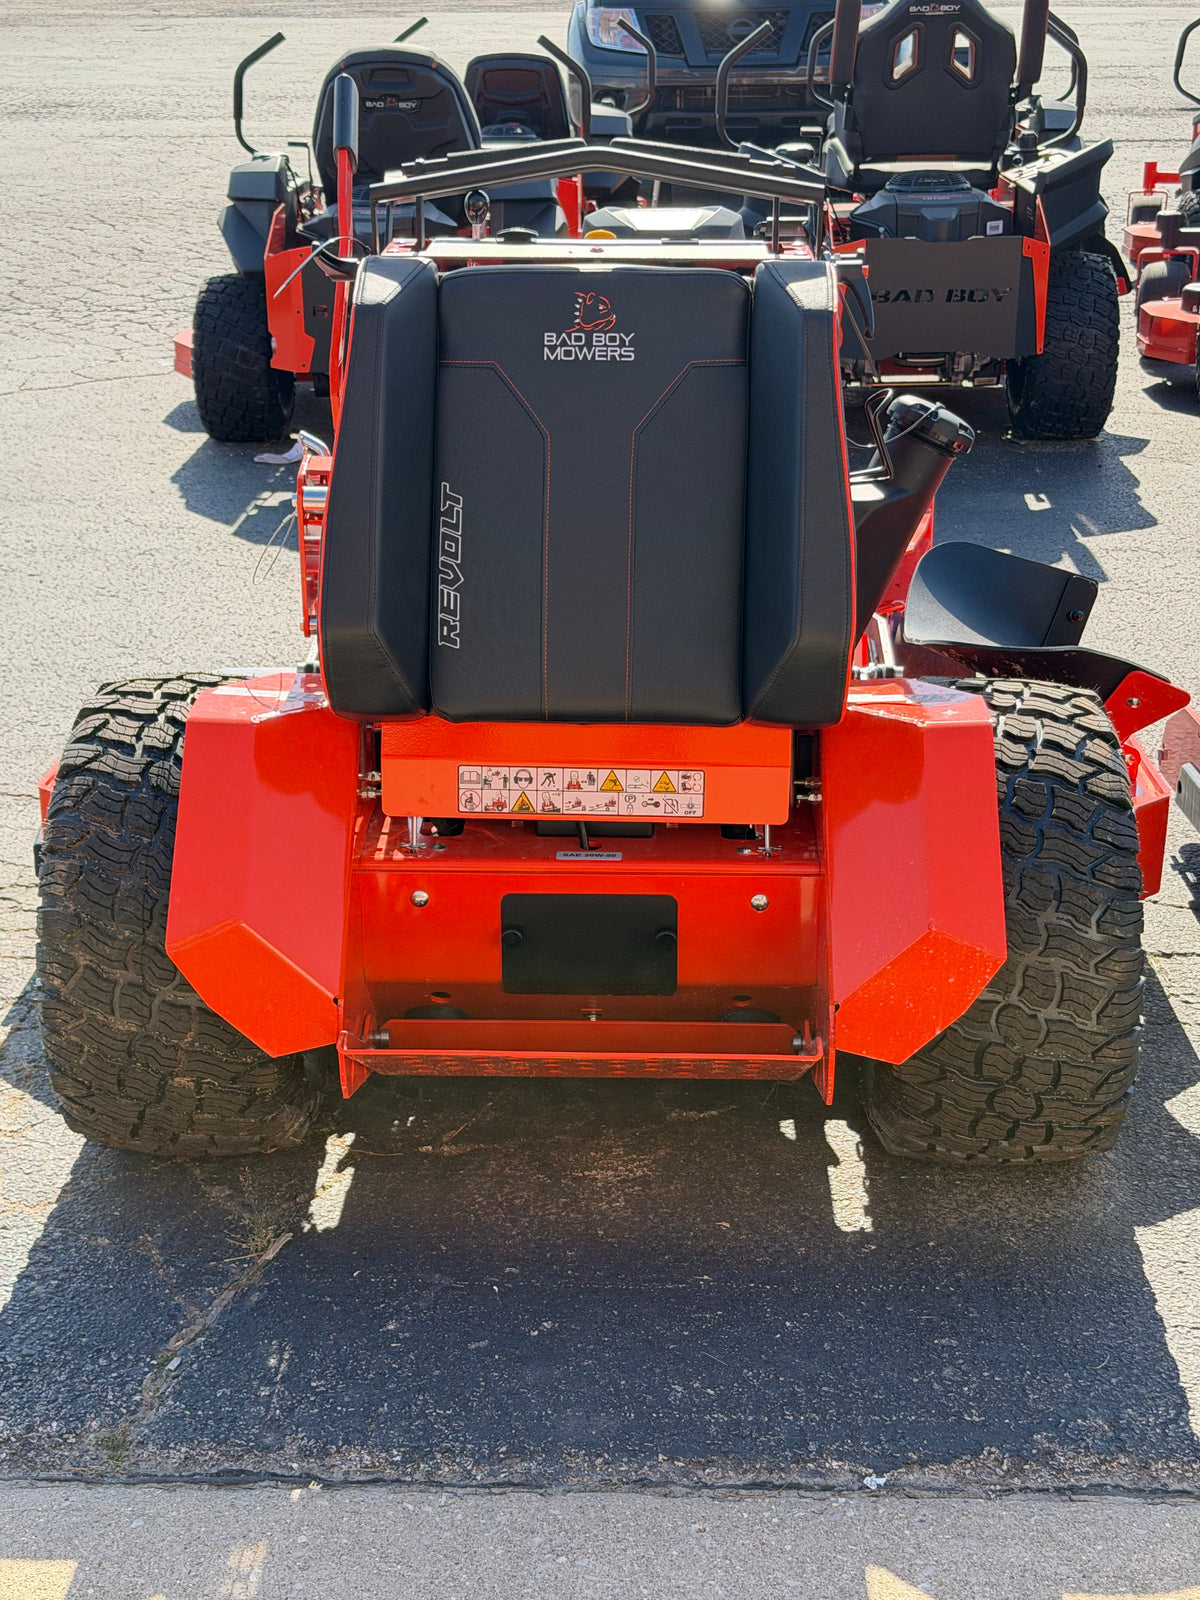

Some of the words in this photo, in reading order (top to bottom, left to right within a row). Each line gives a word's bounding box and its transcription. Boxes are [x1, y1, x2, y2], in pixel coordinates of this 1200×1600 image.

[398, 100, 417, 109] BOY
[871, 289, 935, 304] BAD
[945, 288, 1012, 303] BOY
[543, 332, 585, 346] BAD
[592, 332, 635, 346] BOY
[543, 346, 635, 361] MOWERS
[438, 481, 464, 649] REVOLT
